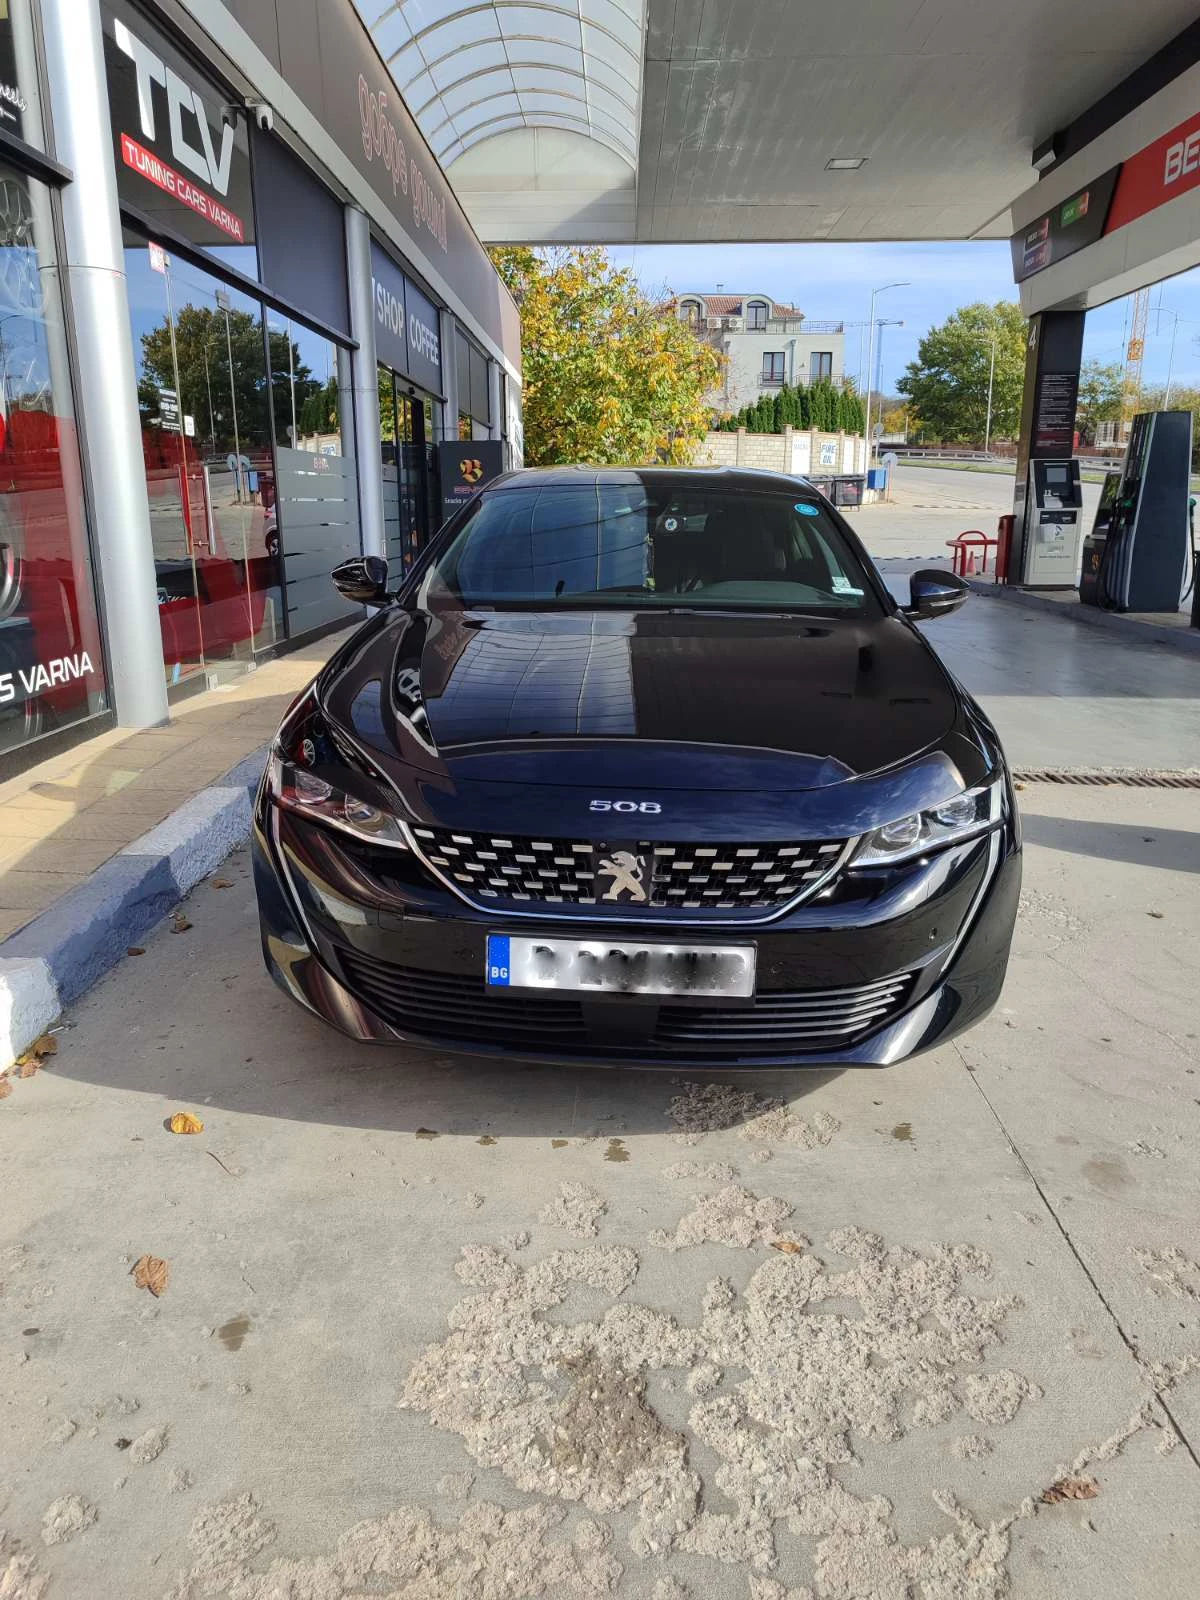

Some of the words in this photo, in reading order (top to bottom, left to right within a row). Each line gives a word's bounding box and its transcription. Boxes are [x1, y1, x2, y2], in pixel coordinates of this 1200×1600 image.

[114, 18, 235, 197] TCV
[1164, 128, 1200, 186] BE
[124, 140, 177, 191] TUNING
[176, 177, 208, 214] CARS
[208, 200, 242, 237] VARNA
[376, 281, 404, 338] SHOP
[409, 313, 439, 366] COFFEE
[19, 650, 95, 694] VARNA
[588, 800, 662, 815] 508
[491, 966, 508, 979] BG
